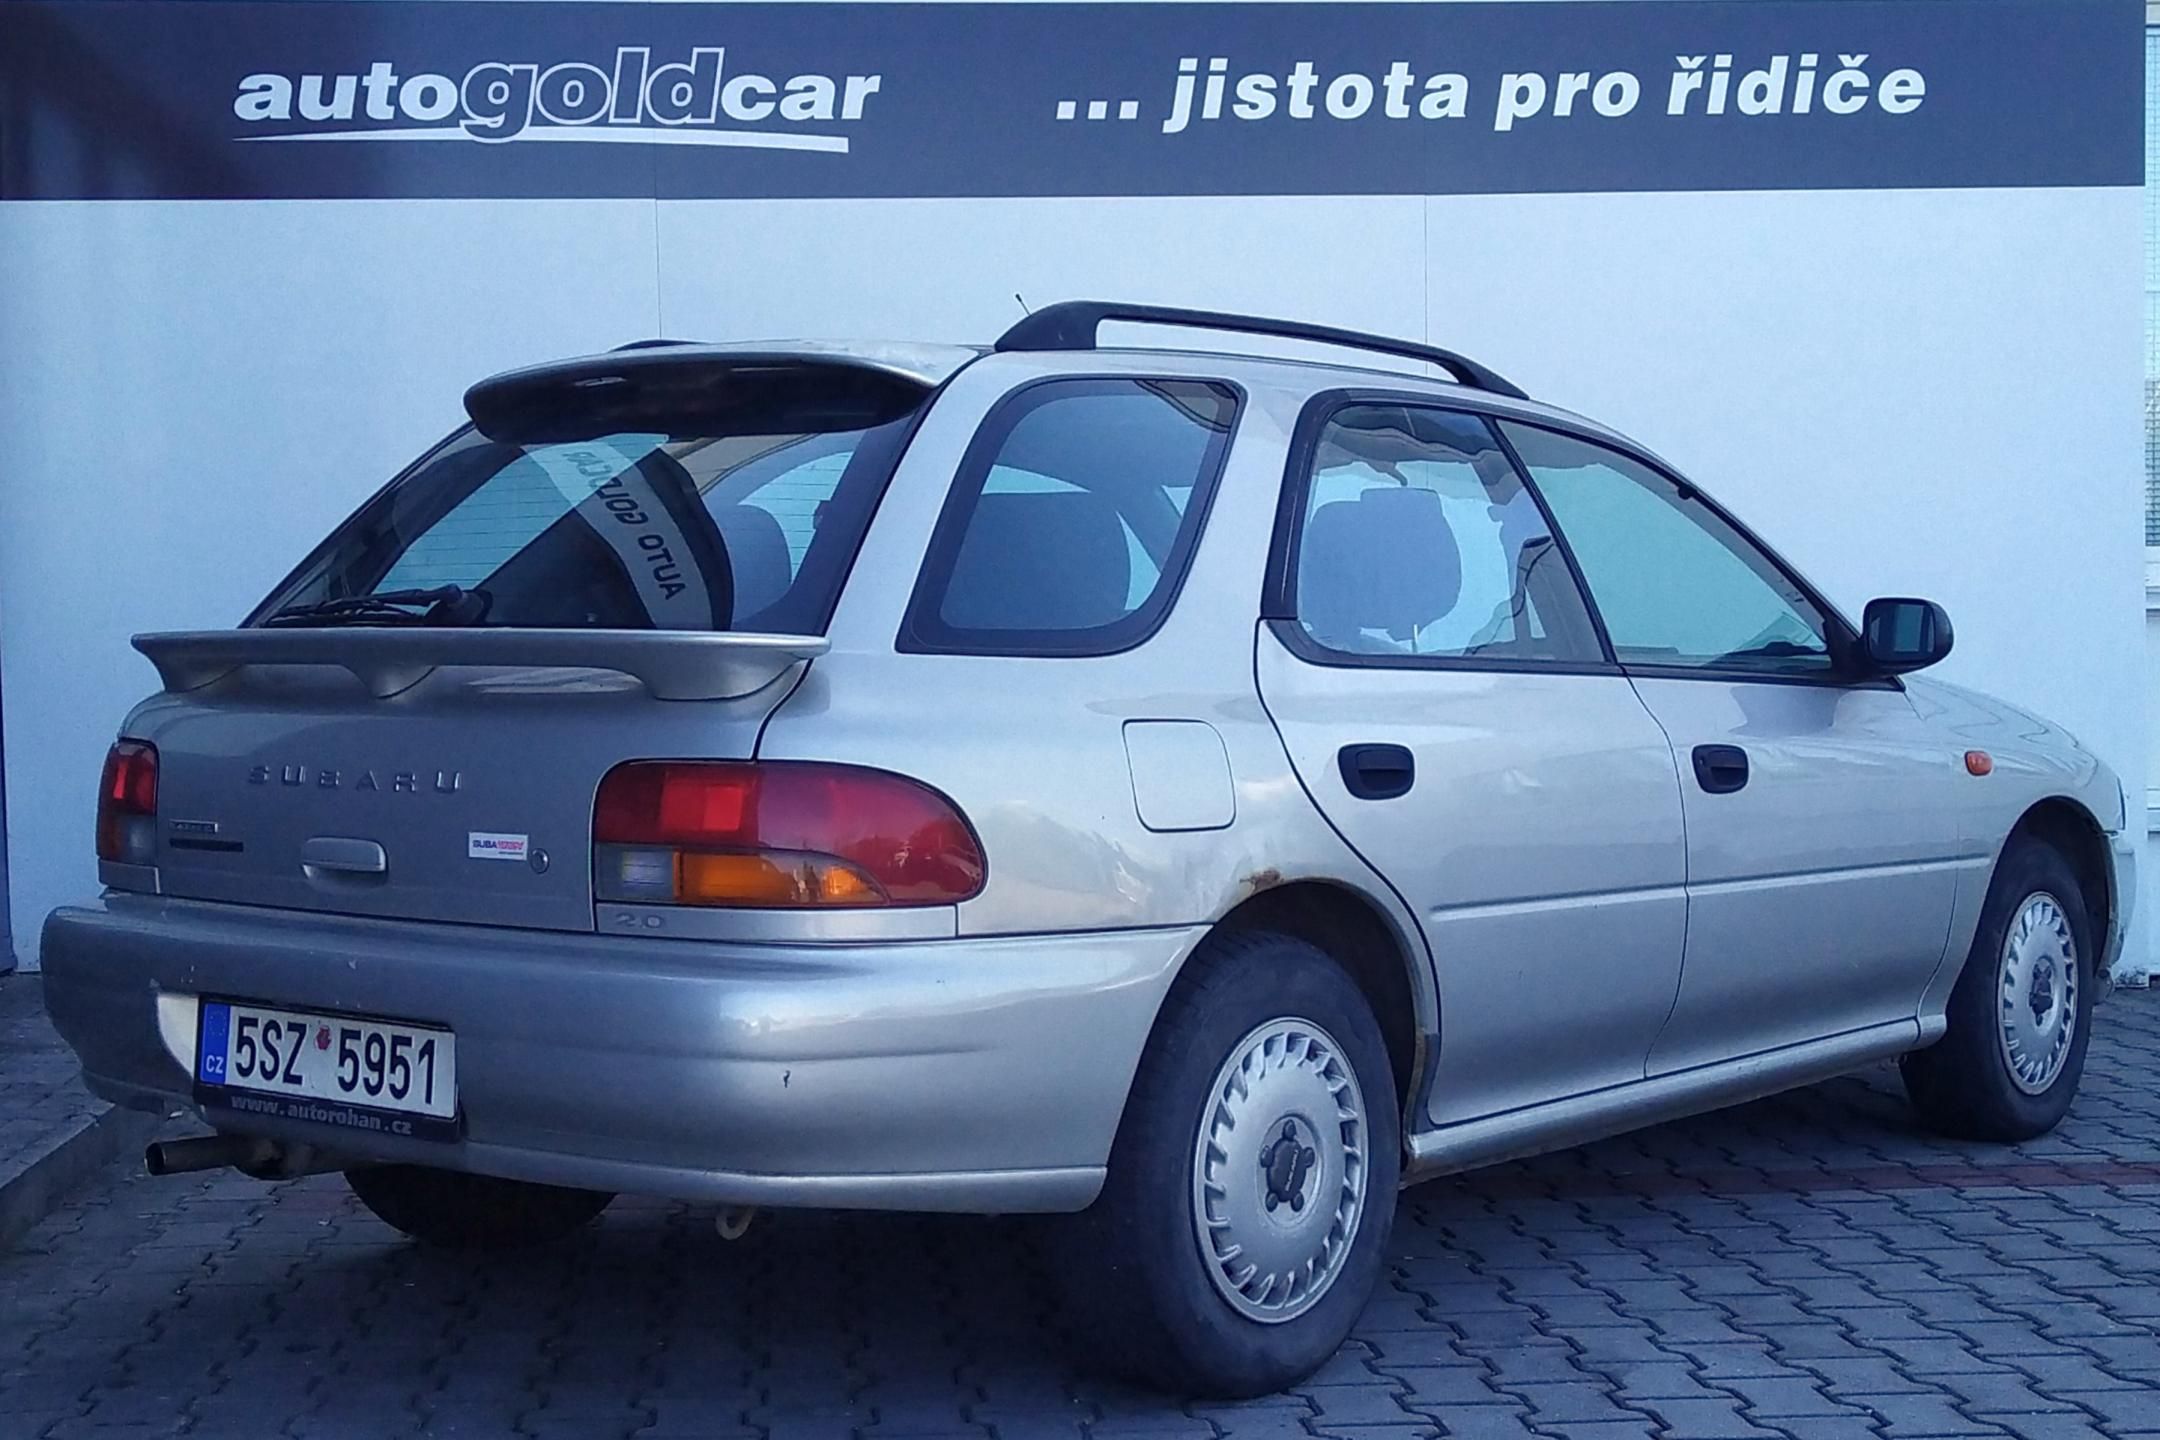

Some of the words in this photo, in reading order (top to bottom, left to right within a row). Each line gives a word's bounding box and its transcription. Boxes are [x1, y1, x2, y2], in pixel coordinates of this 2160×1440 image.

[234, 47, 881, 142] autogoldcar
[1162, 58, 1468, 133] jistota
[1494, 71, 1640, 131] pro
[1667, 54, 1925, 115] řidiče
[247, 764, 463, 794] SUBARU
[205, 1054, 224, 1074] CZ
[235, 1016, 307, 1085] 5SZ
[338, 1028, 436, 1105] 5951
[231, 1096, 412, 1135] www.autorohan.cz
